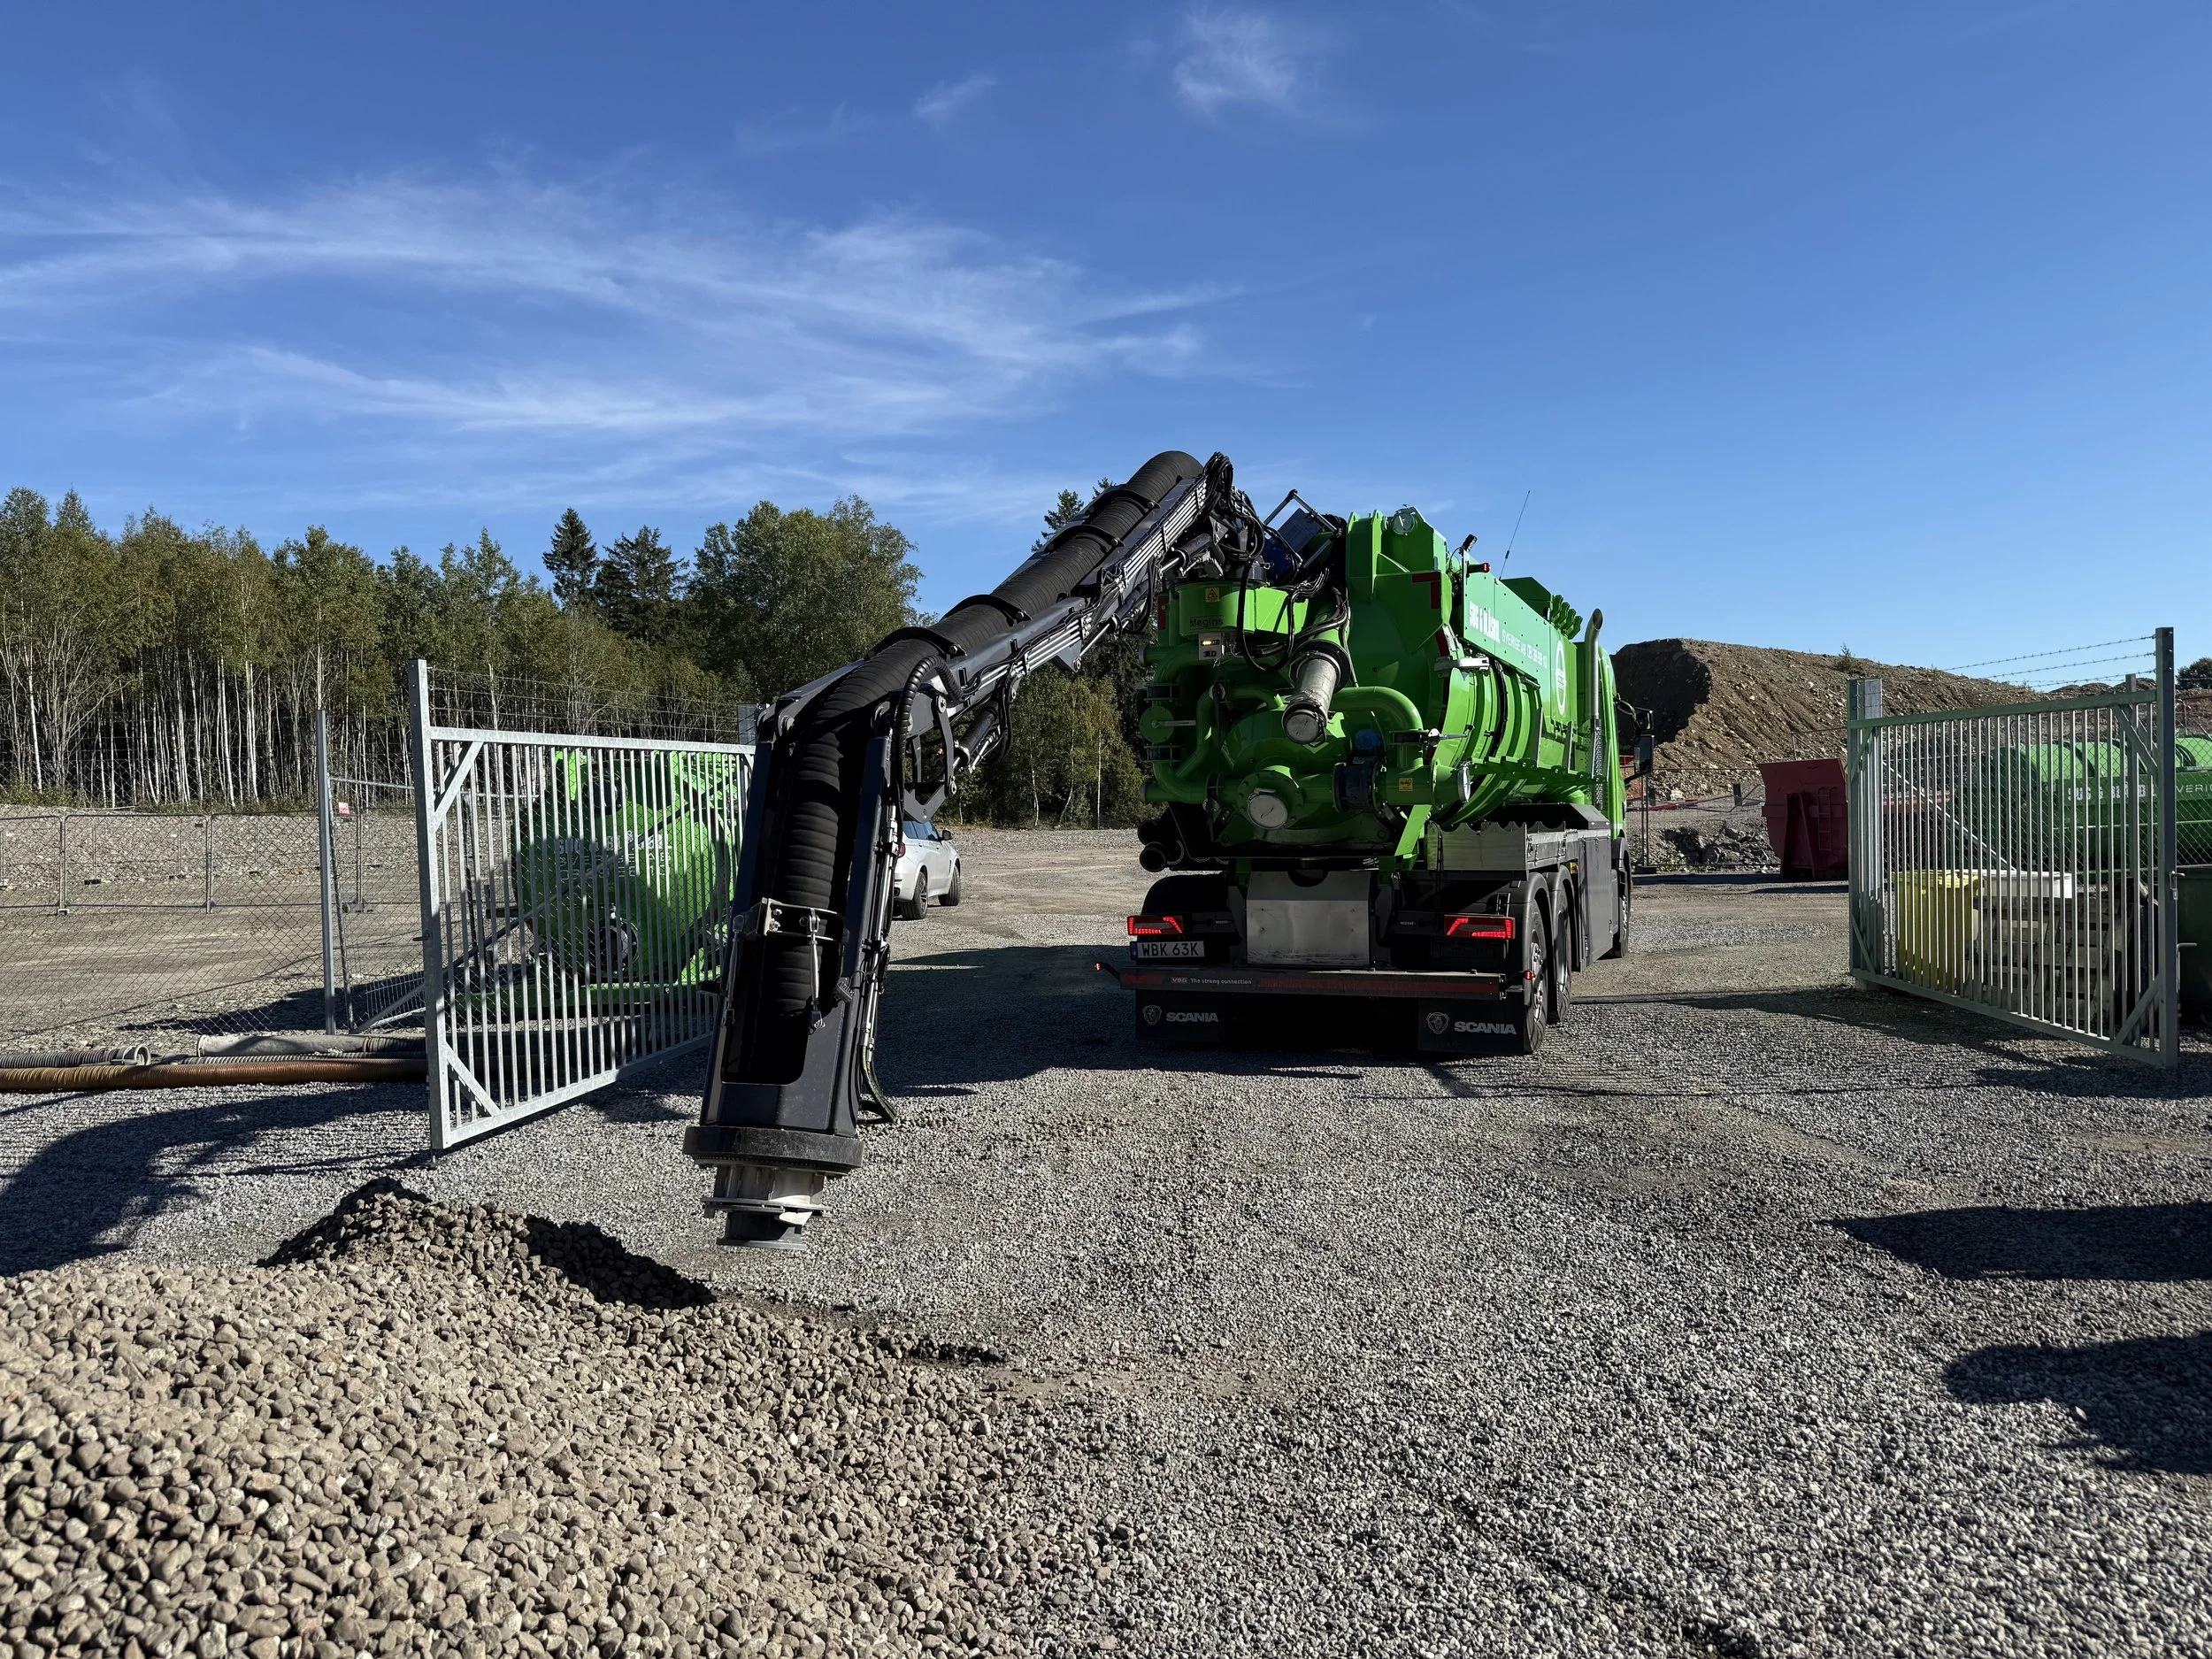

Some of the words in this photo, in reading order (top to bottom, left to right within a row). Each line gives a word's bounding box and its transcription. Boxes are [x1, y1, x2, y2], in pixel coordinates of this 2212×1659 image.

[1189, 618, 1224, 628] Megins
[1141, 943, 1169, 956] WBK
[1171, 942, 1198, 956] 63K
[1165, 1011, 1219, 1023] SCANIA
[1454, 1021, 1517, 1035] SCANIA
